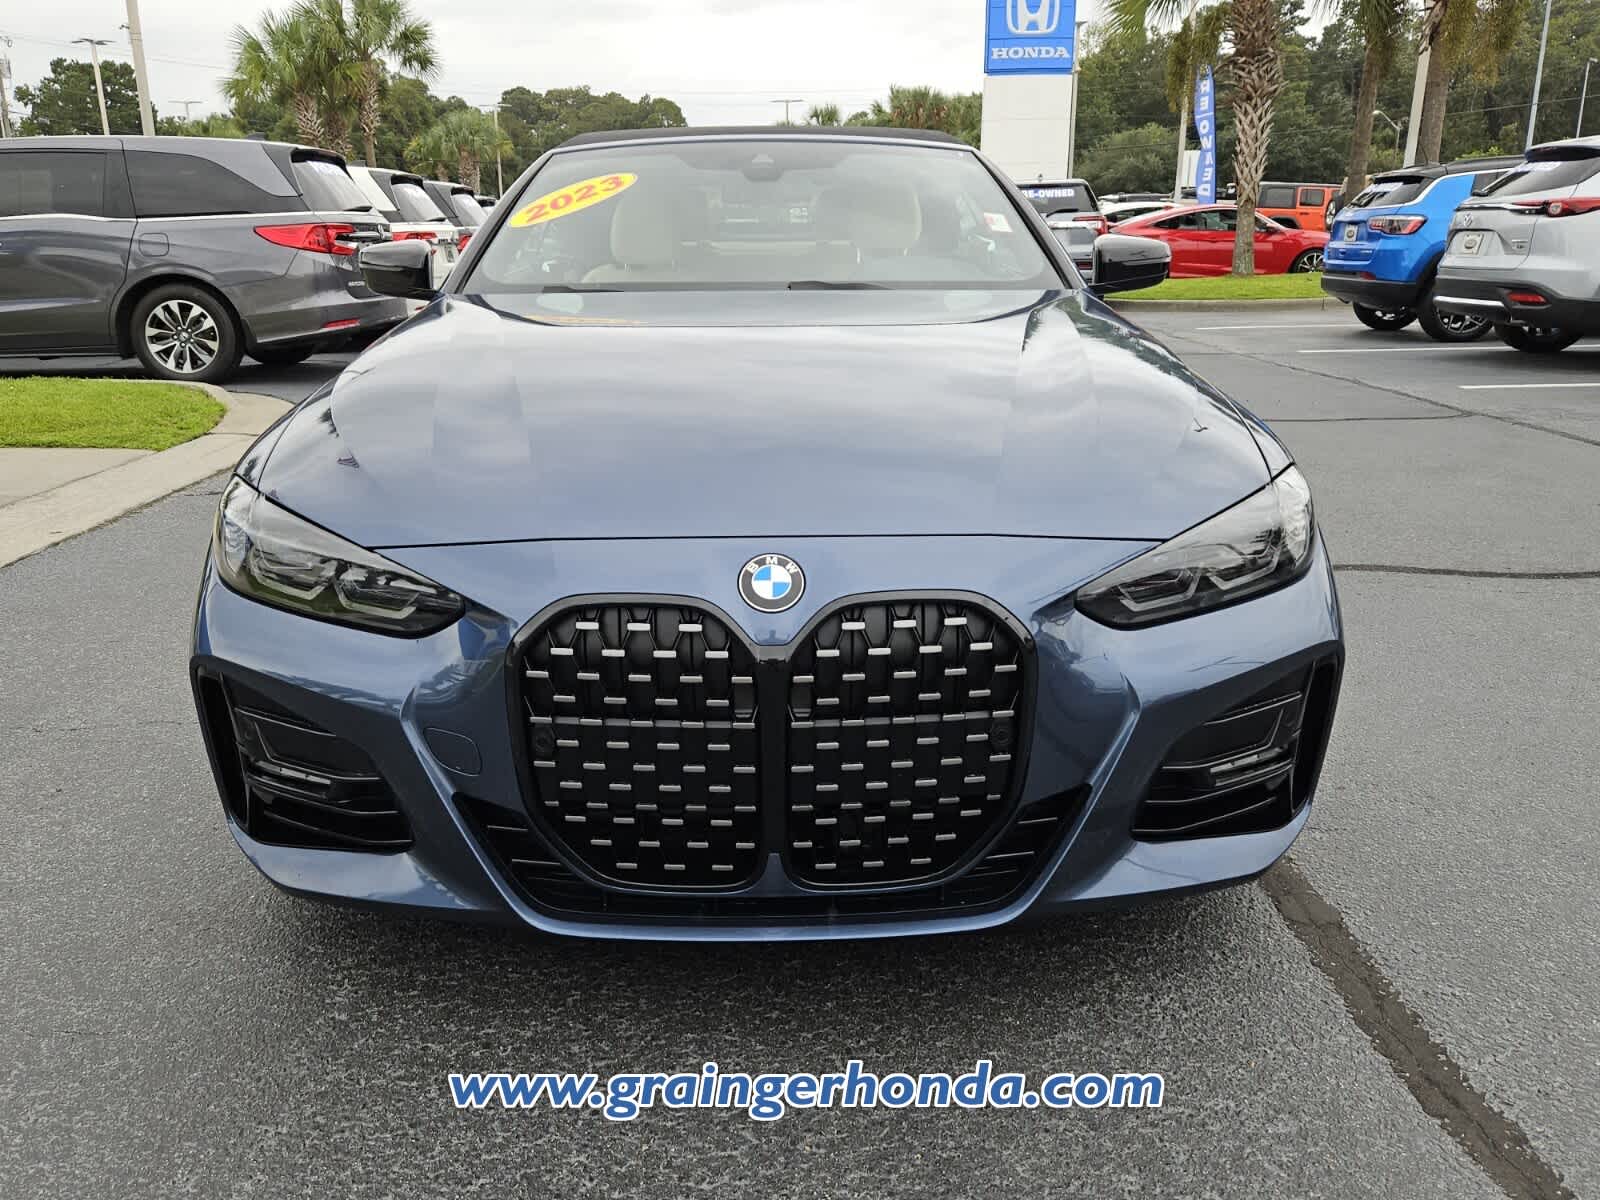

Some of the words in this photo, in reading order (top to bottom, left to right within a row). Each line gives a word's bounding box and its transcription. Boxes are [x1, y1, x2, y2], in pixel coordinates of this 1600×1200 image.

[991, 47, 1071, 59] HONDA
[525, 175, 624, 223] 2023
[746, 556, 799, 574] BMW
